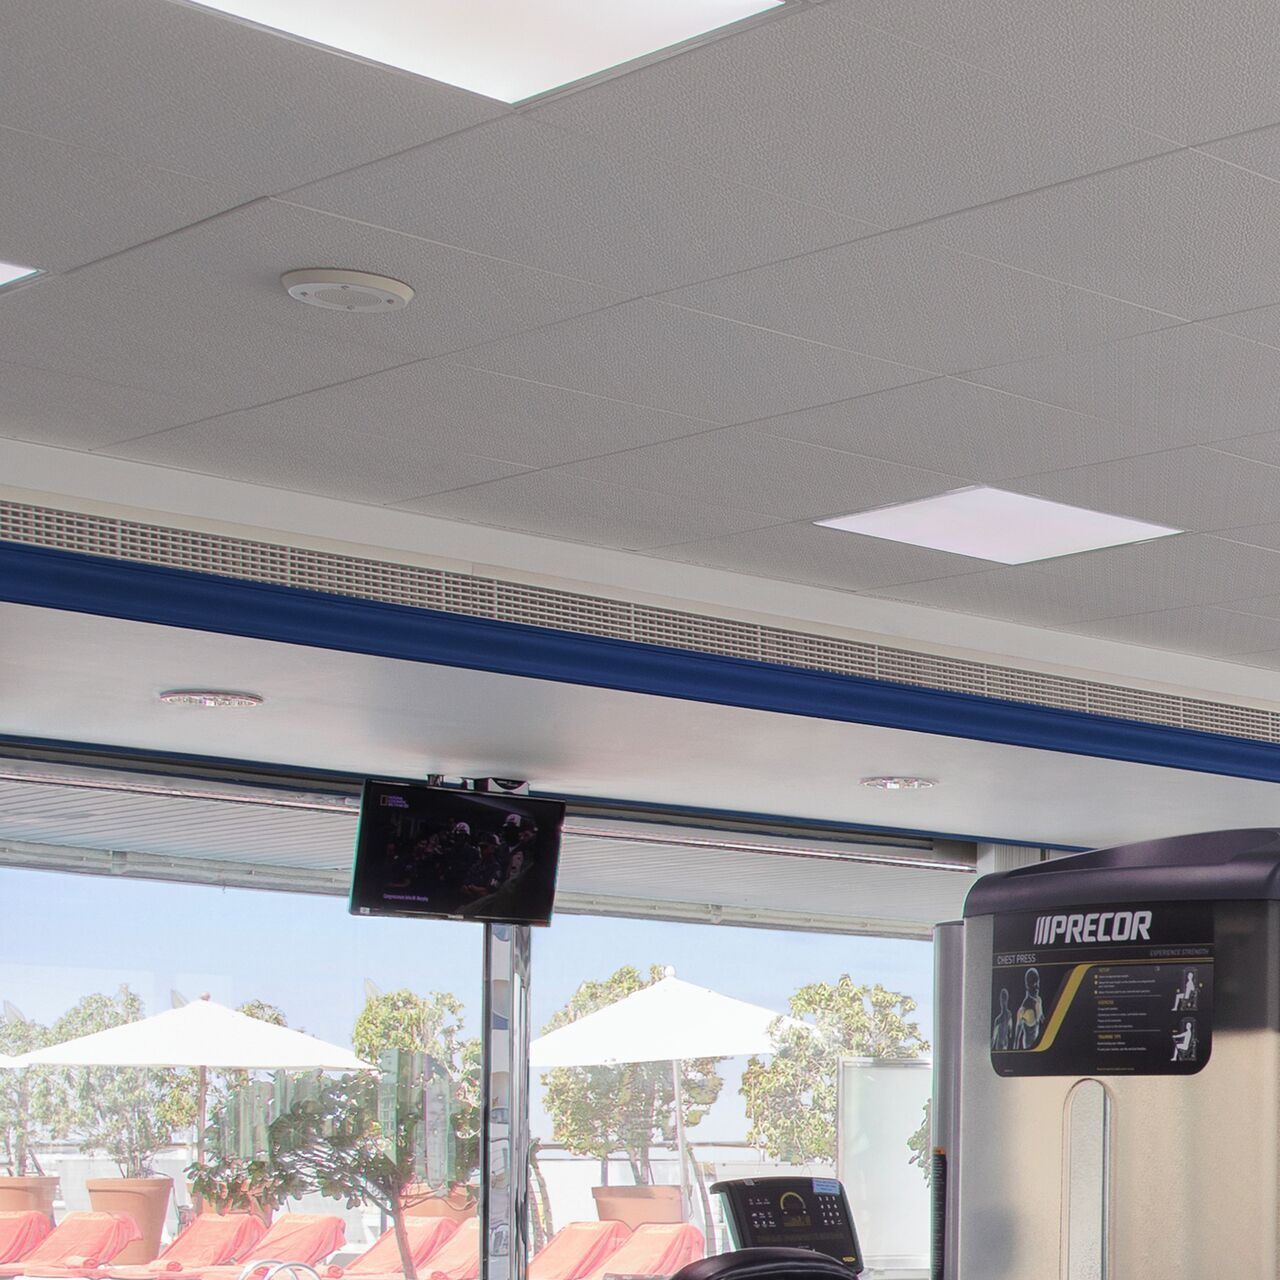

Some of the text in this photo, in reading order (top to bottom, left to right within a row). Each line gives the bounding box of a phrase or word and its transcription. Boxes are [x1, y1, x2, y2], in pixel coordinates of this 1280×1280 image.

[1048, 910, 1152, 945] PRECOR
[997, 953, 1036, 965] CHEST PRESS
